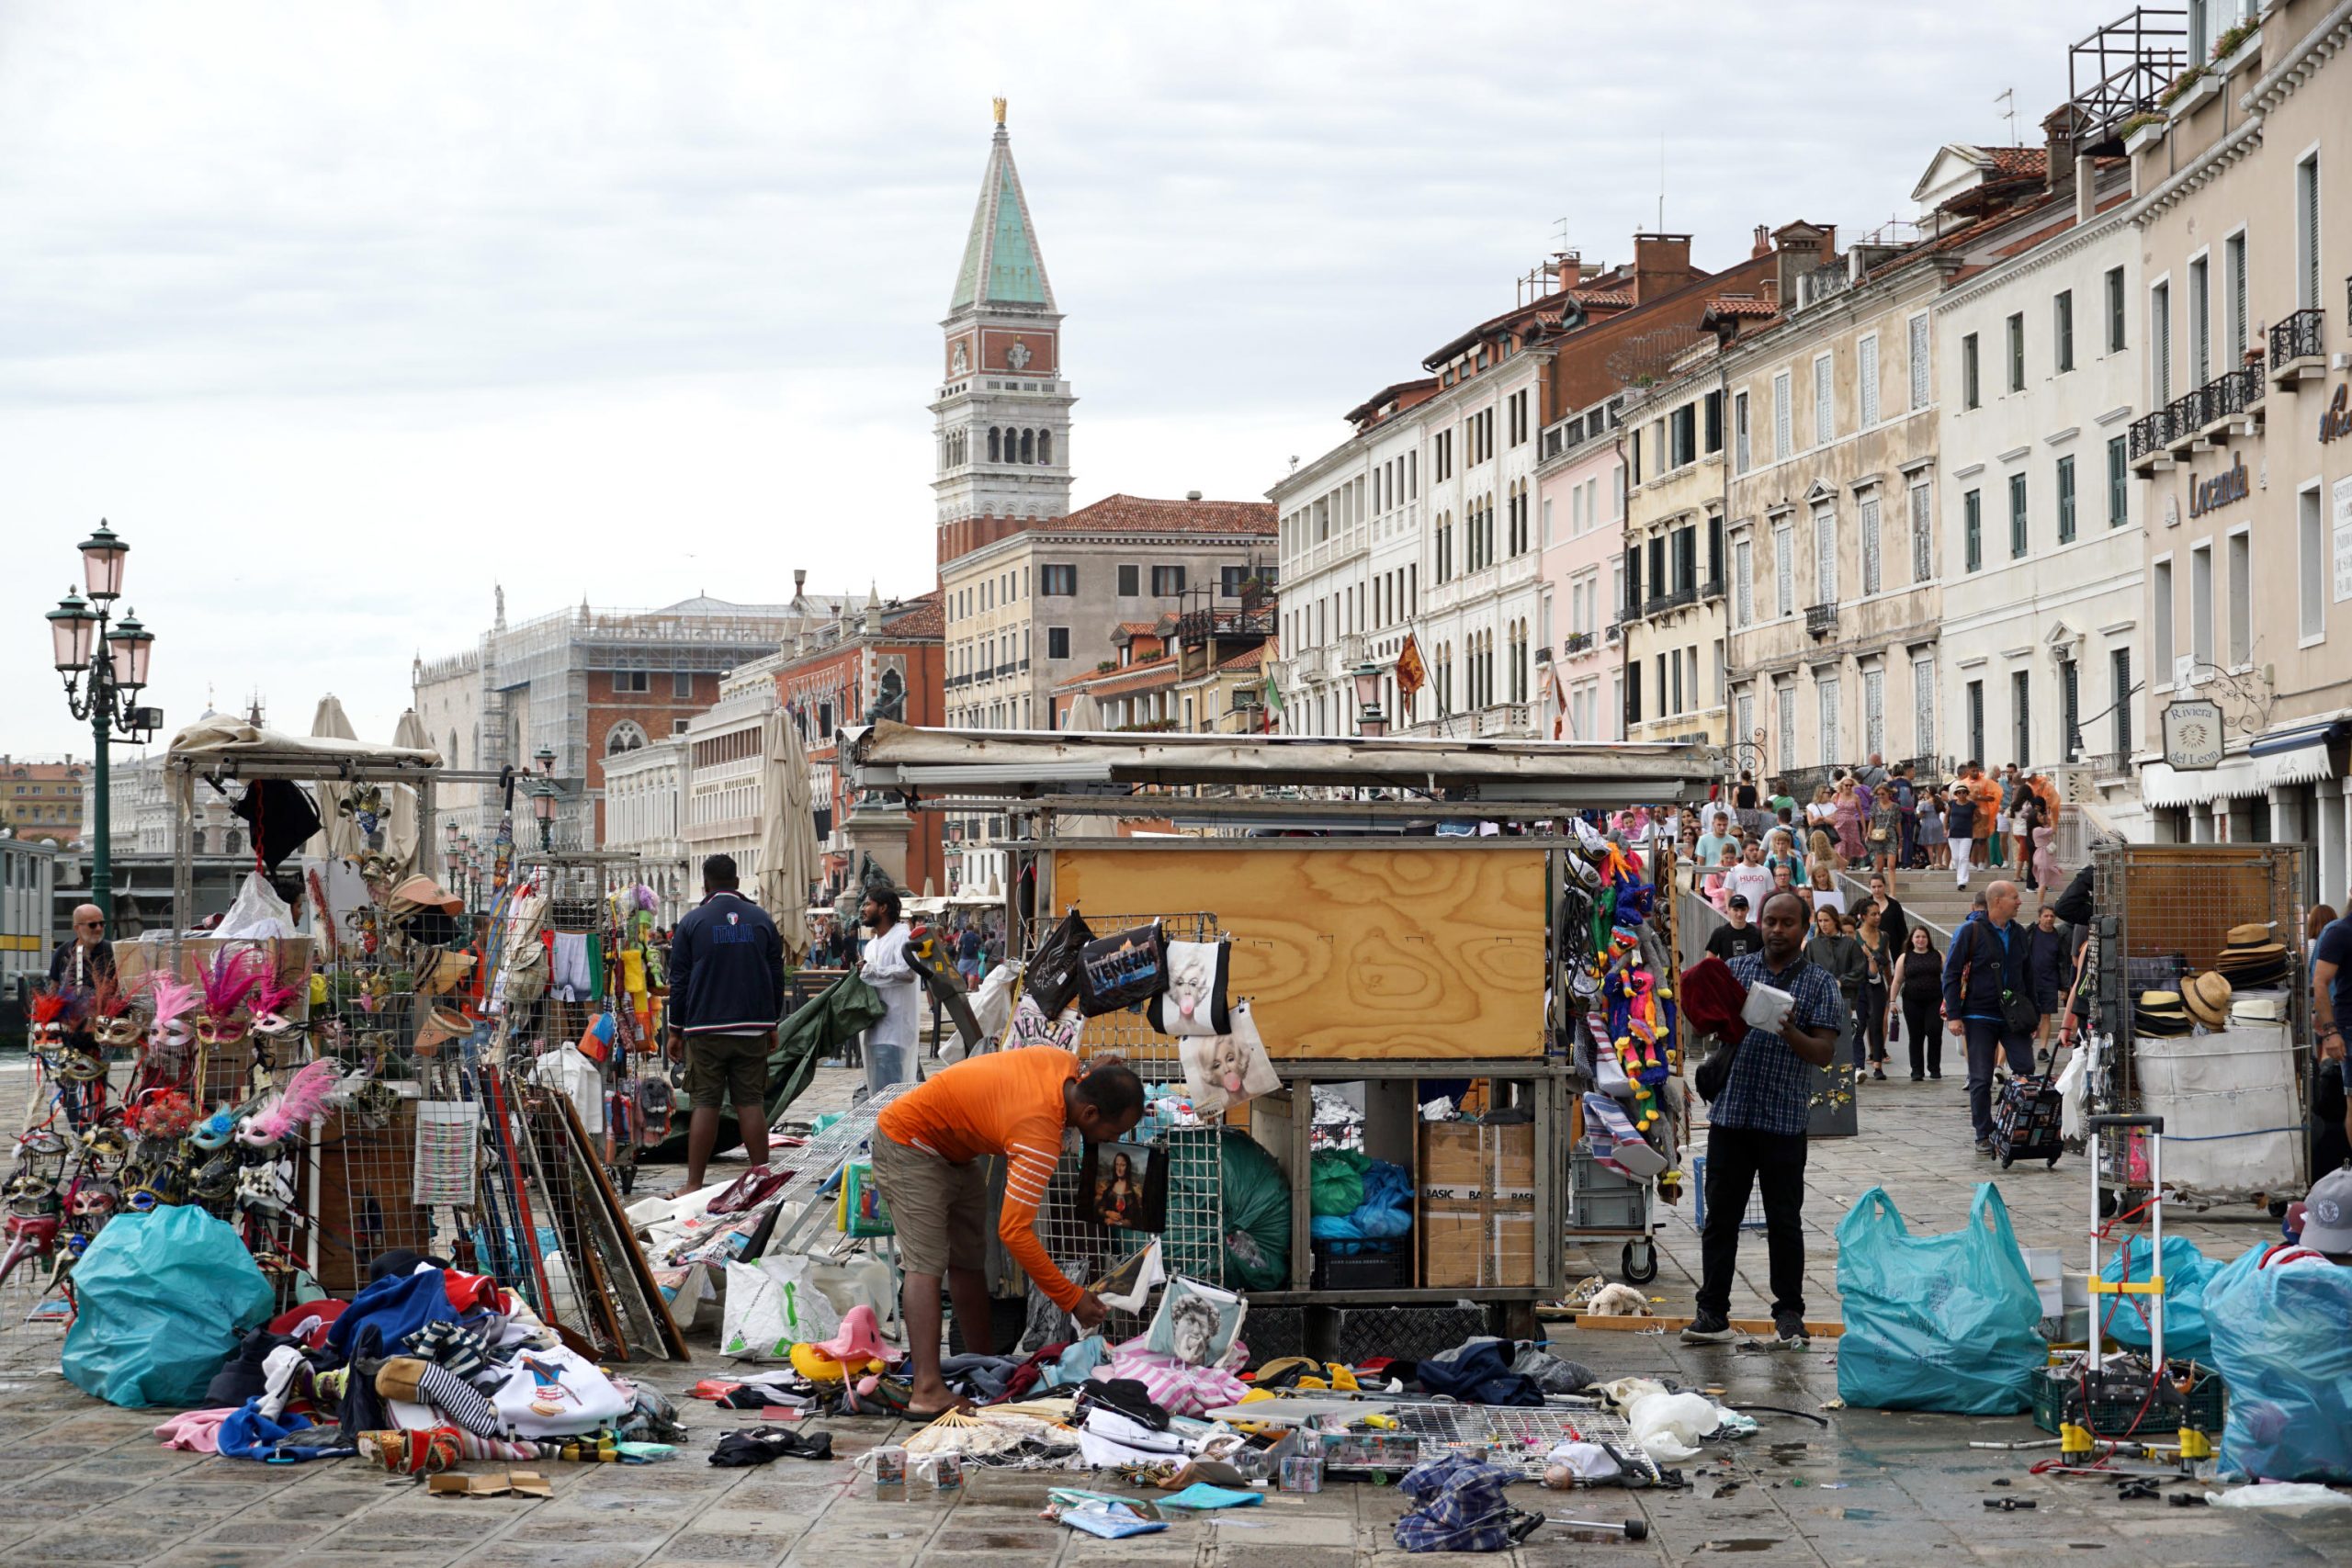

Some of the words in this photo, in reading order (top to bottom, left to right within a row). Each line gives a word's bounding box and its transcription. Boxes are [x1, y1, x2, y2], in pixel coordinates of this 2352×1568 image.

[2188, 451, 2250, 519] Locanda
[2171, 705, 2212, 720] Riviera
[2169, 751, 2186, 764] del
[2190, 750, 2220, 765] Leon
[725, 776, 755, 790] EXCELSIOR
[712, 924, 754, 943] ITALIA
[1088, 949, 1154, 986] VENEZIA
[1014, 1017, 1074, 1049] VENEZIA
[1426, 1190, 1453, 1199] BASIC
